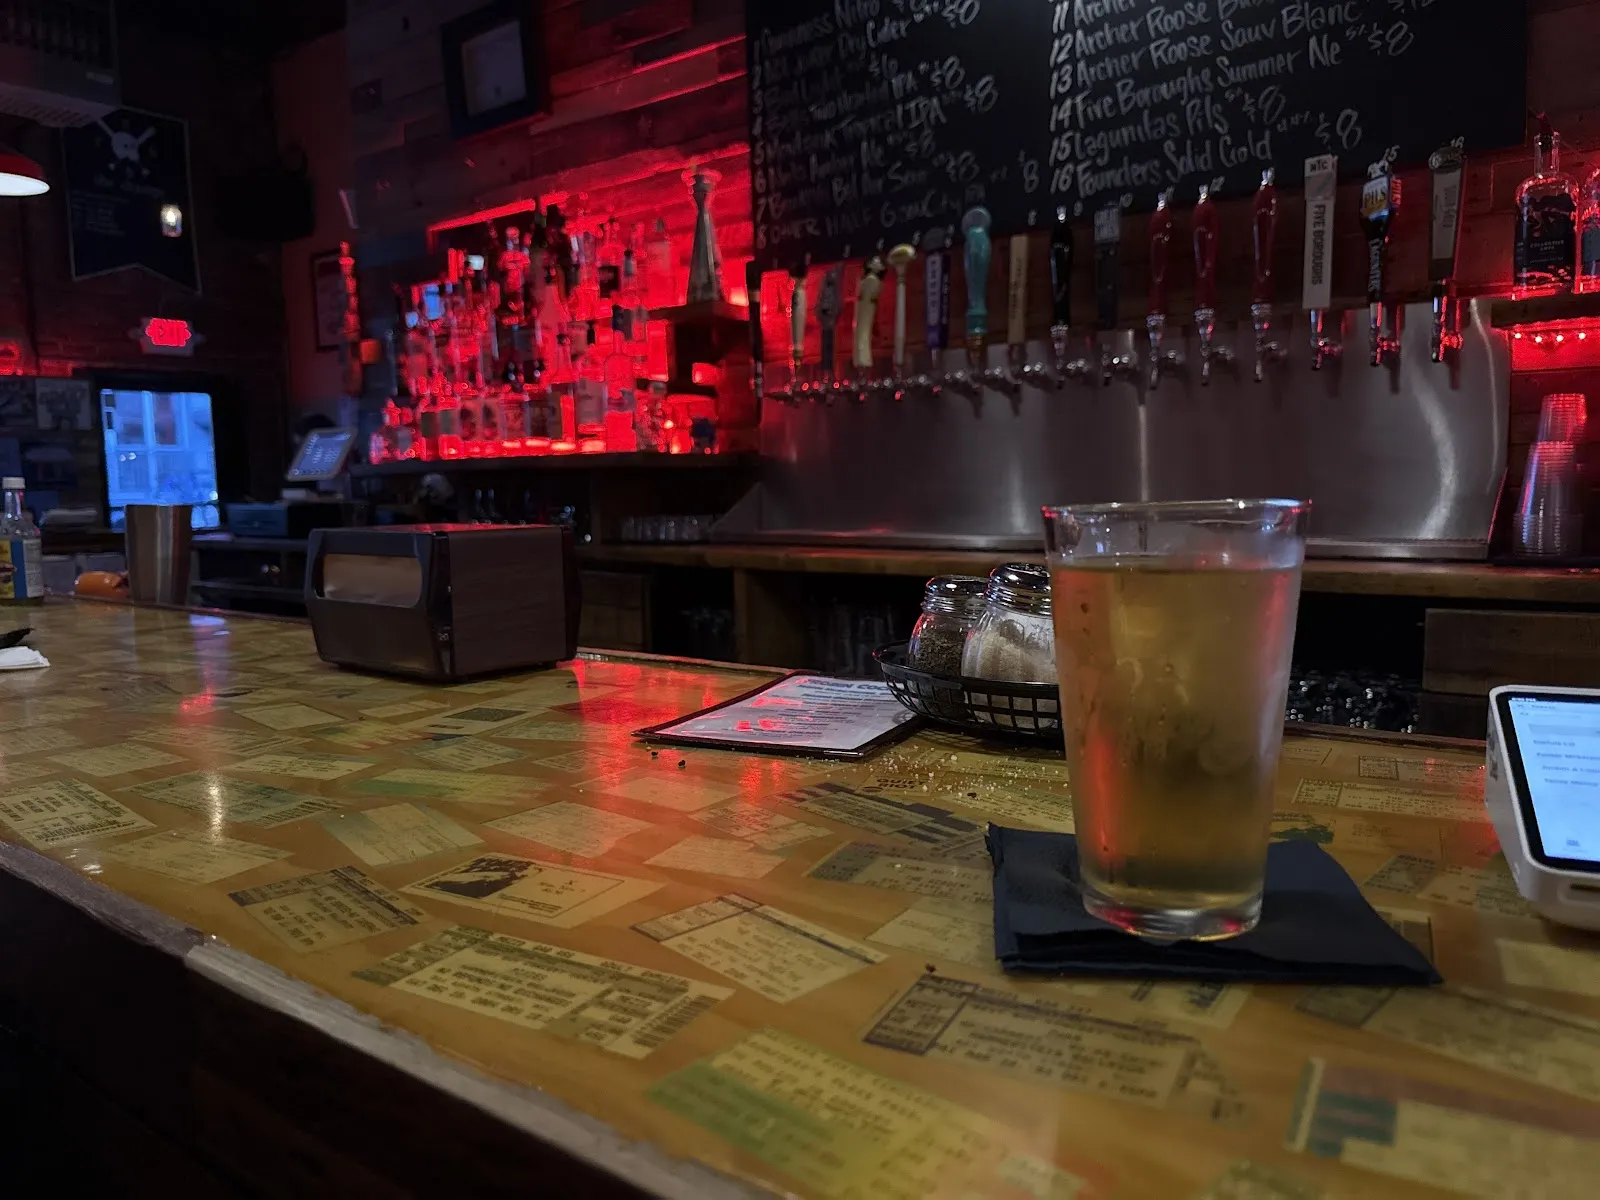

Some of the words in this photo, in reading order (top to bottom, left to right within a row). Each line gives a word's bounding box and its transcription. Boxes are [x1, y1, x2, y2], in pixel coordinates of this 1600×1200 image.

[1050, 33, 1074, 69] 12
[1075, 15, 1146, 61] Archer
[1146, 3, 1212, 40] Roose
[1050, 64, 1074, 101] 13
[1077, 45, 1148, 90] Archer
[1148, 38, 1214, 71] Roose
[1219, 17, 1277, 52] Sauv
[1280, 0, 1362, 40] Blanc
[1049, 97, 1073, 133] 14
[1074, 86, 1117, 131] Five
[1115, 66, 1215, 117] Boroughs
[1216, 48, 1303, 88] Summer
[1367, 20, 1416, 58] $8
[1049, 130, 1075, 168] 15
[1075, 108, 1182, 168] Lagunitas
[1185, 93, 1231, 138] Pils
[1049, 162, 1076, 195] 16
[1077, 156, 1161, 200] Founders
[1162, 138, 1214, 184] Solid
[1219, 128, 1274, 169] Gold
[1313, 203, 1326, 230] FIVE
[1311, 230, 1325, 287] BOROUGHS
